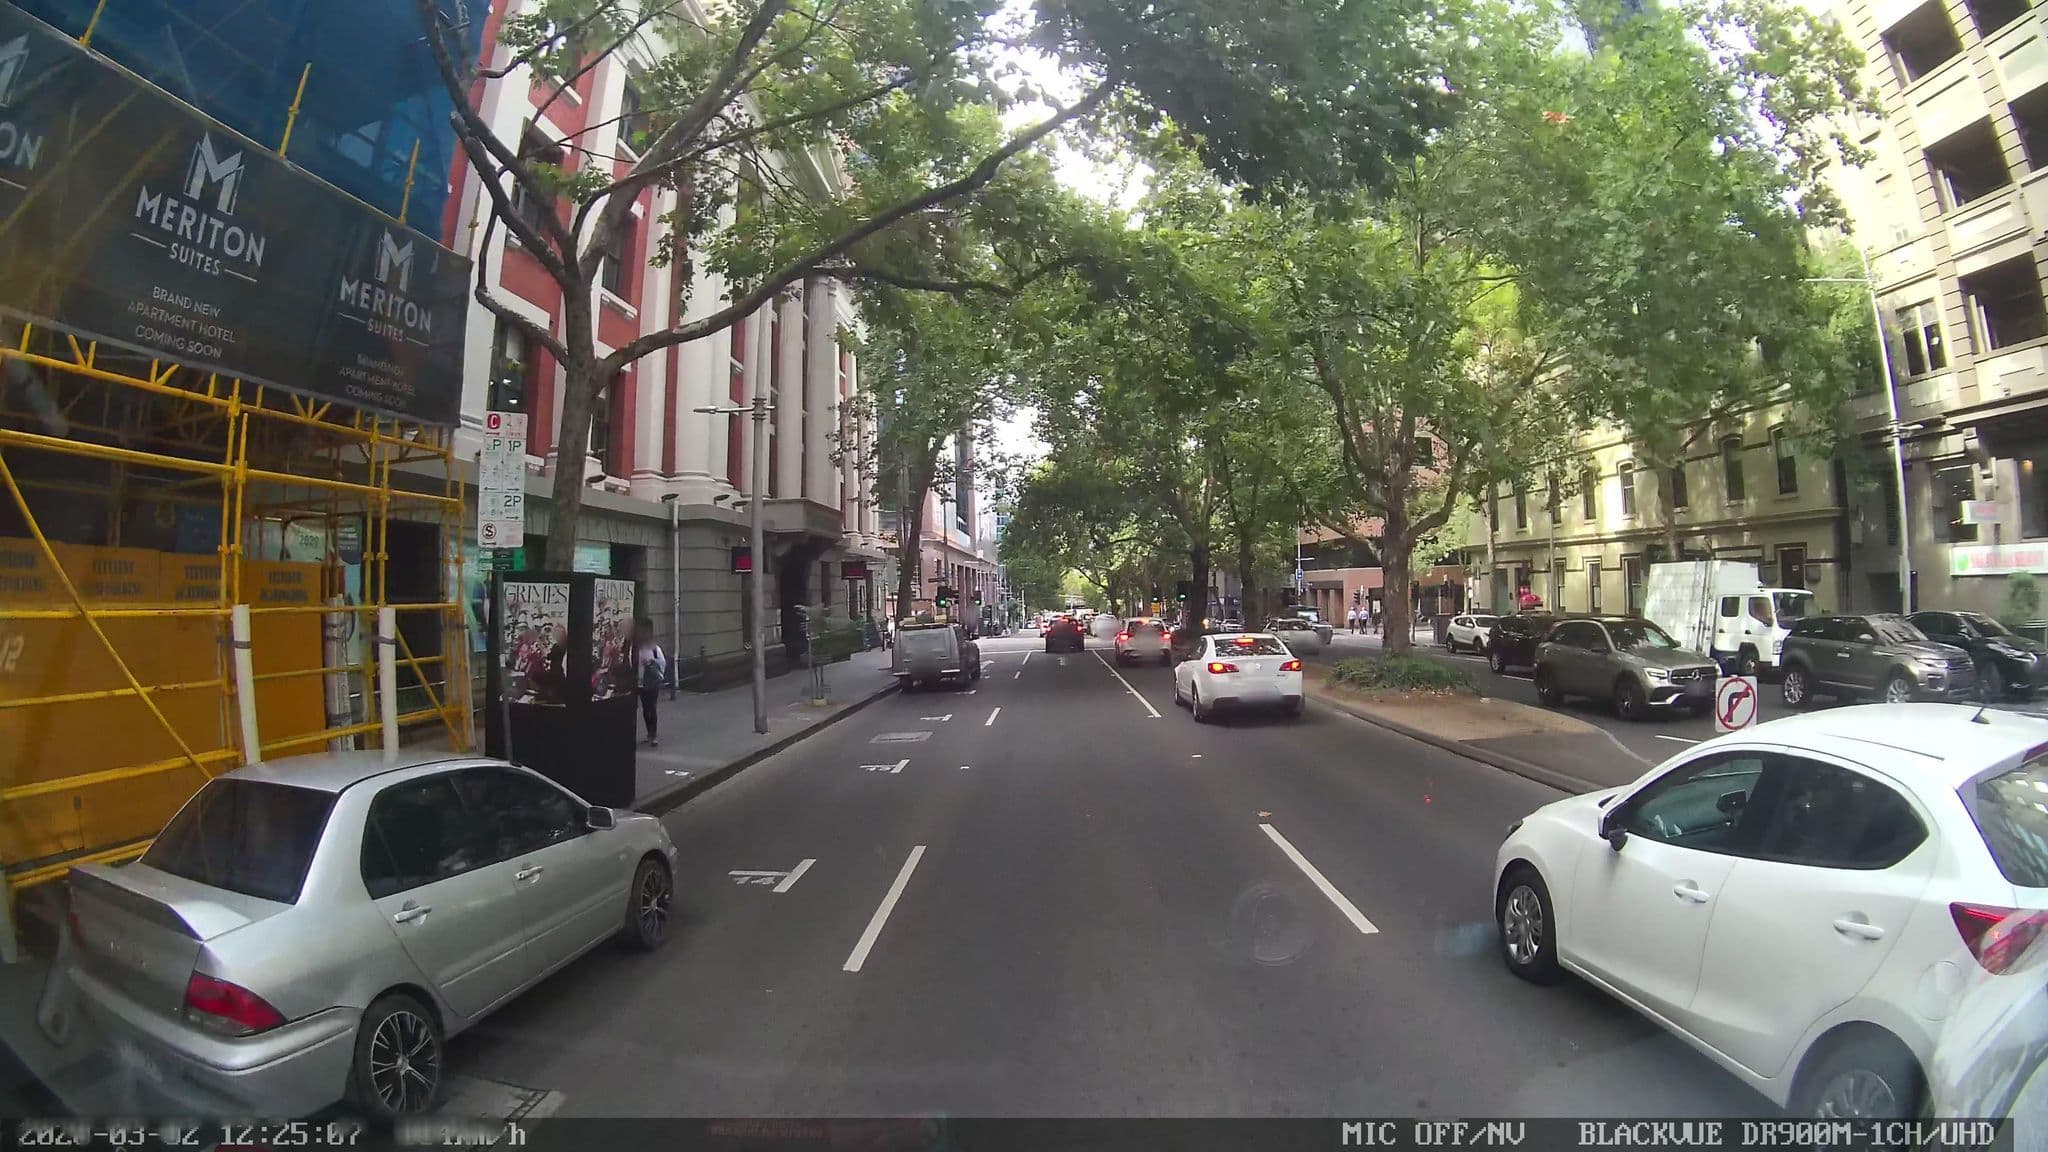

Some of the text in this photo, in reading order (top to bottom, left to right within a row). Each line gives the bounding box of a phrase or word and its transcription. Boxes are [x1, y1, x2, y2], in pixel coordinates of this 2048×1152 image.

[135, 184, 266, 267] MERITON
[169, 242, 221, 275] SUITES
[153, 286, 221, 317] BRAND NEW
[340, 275, 432, 334] MERITON
[128, 301, 236, 343] APARTMENT HOTEL
[367, 318, 404, 342] SUITES
[136, 325, 222, 358] COMING SOON
[508, 440, 521, 452] 1P
[504, 495, 522, 507] 2P
[505, 584, 568, 604] GRIMES
[594, 583, 633, 600] GRIMES
